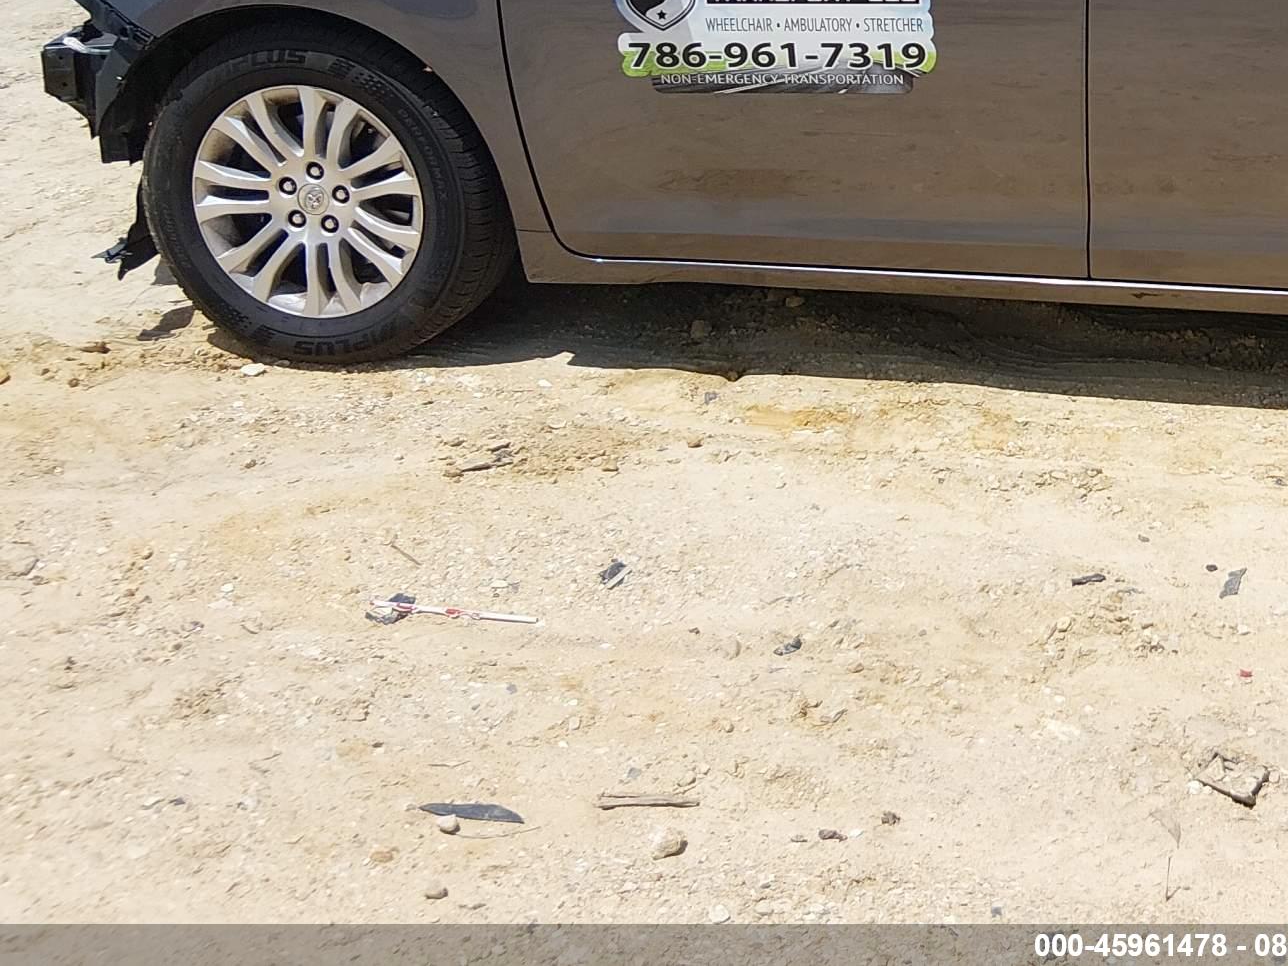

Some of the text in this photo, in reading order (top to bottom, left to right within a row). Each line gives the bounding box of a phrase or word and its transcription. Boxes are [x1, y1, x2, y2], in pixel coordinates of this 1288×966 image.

[705, 17, 923, 32] WHEELCHAIR AMBULATORY STRETCHER
[628, 42, 926, 68] 786-961-7319
[661, 72, 904, 85] NON-EMERGENCY TRANSPORTATION
